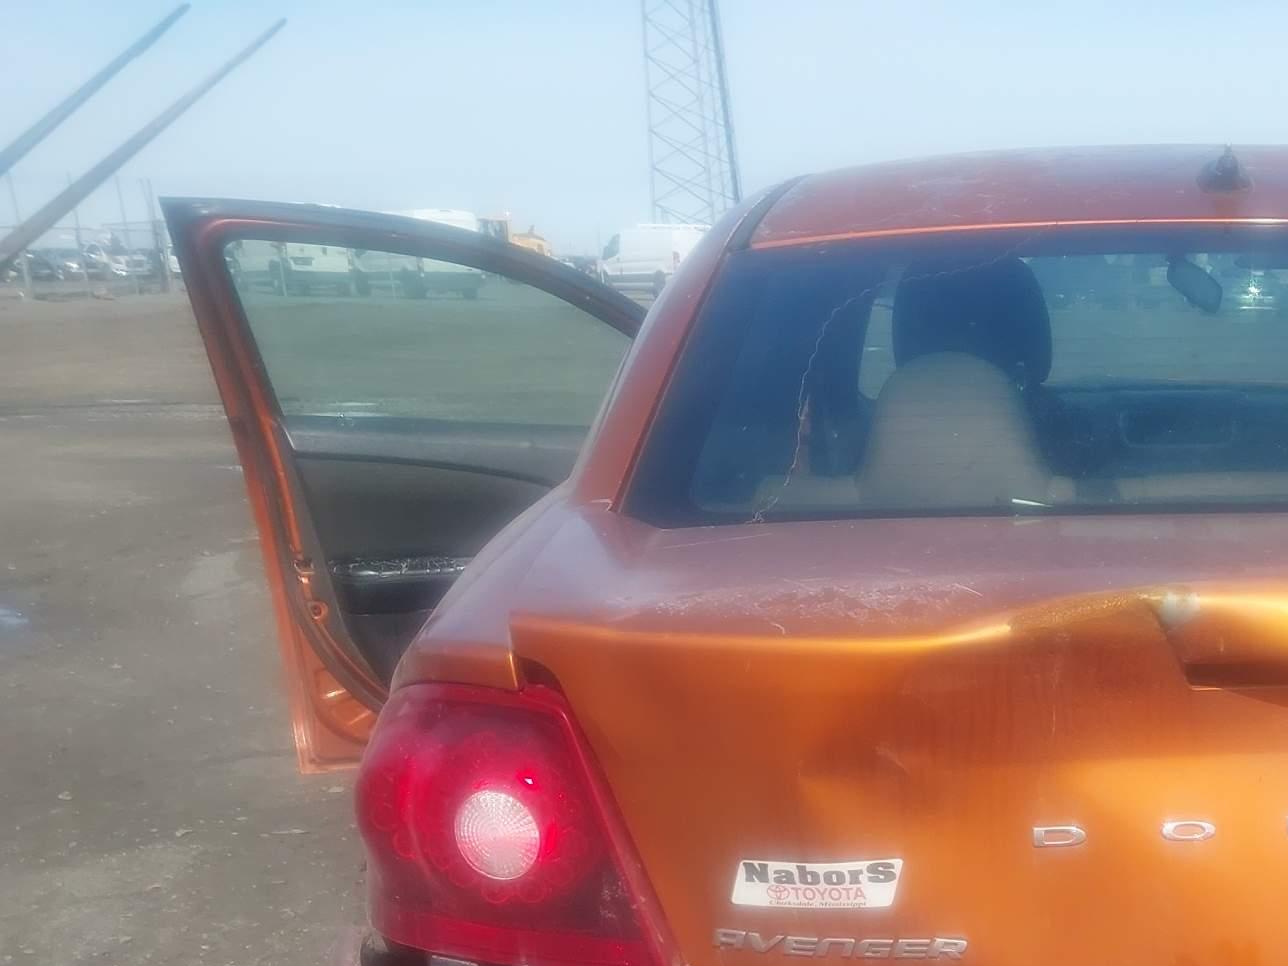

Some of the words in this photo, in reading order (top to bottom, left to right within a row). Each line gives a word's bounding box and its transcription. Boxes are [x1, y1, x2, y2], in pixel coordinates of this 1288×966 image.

[742, 861, 897, 886] NaborS
[790, 886, 866, 901] TOYOTA
[713, 927, 968, 960] AVENGER
